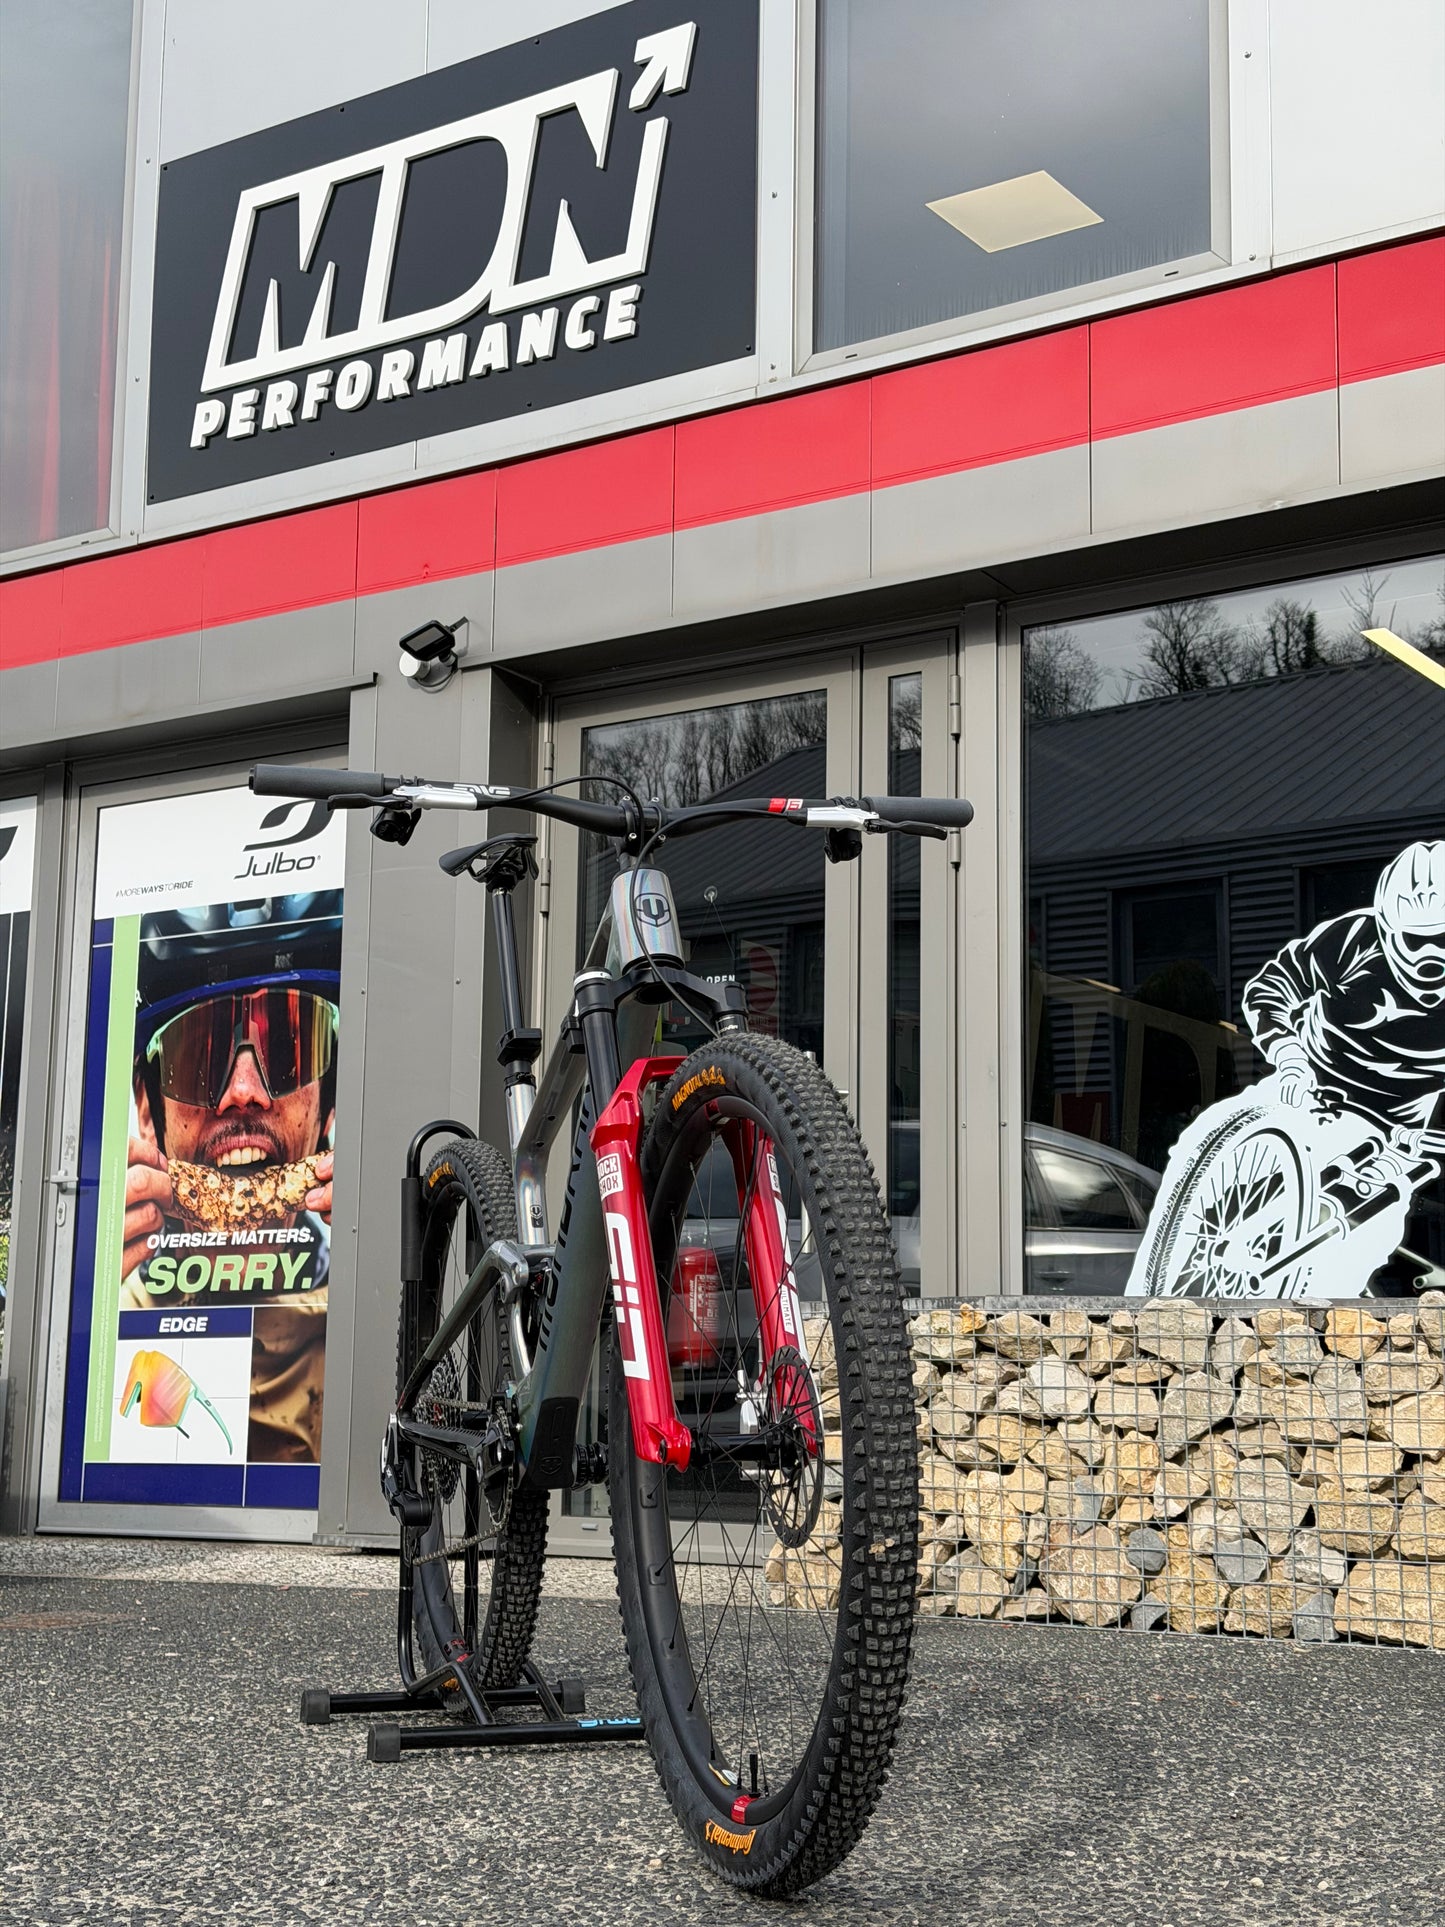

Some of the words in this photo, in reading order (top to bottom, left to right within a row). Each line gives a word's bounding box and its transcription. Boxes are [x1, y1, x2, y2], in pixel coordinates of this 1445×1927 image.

[201, 67, 670, 393] MDN
[189, 284, 642, 449] PERFORMANCE
[233, 851, 316, 880] Julbo
[146, 1231, 228, 1250] OVERSIZE
[231, 1226, 315, 1246] MATTERS.
[145, 1251, 313, 1295] SORRY.
[158, 1316, 209, 1333] EDGE
